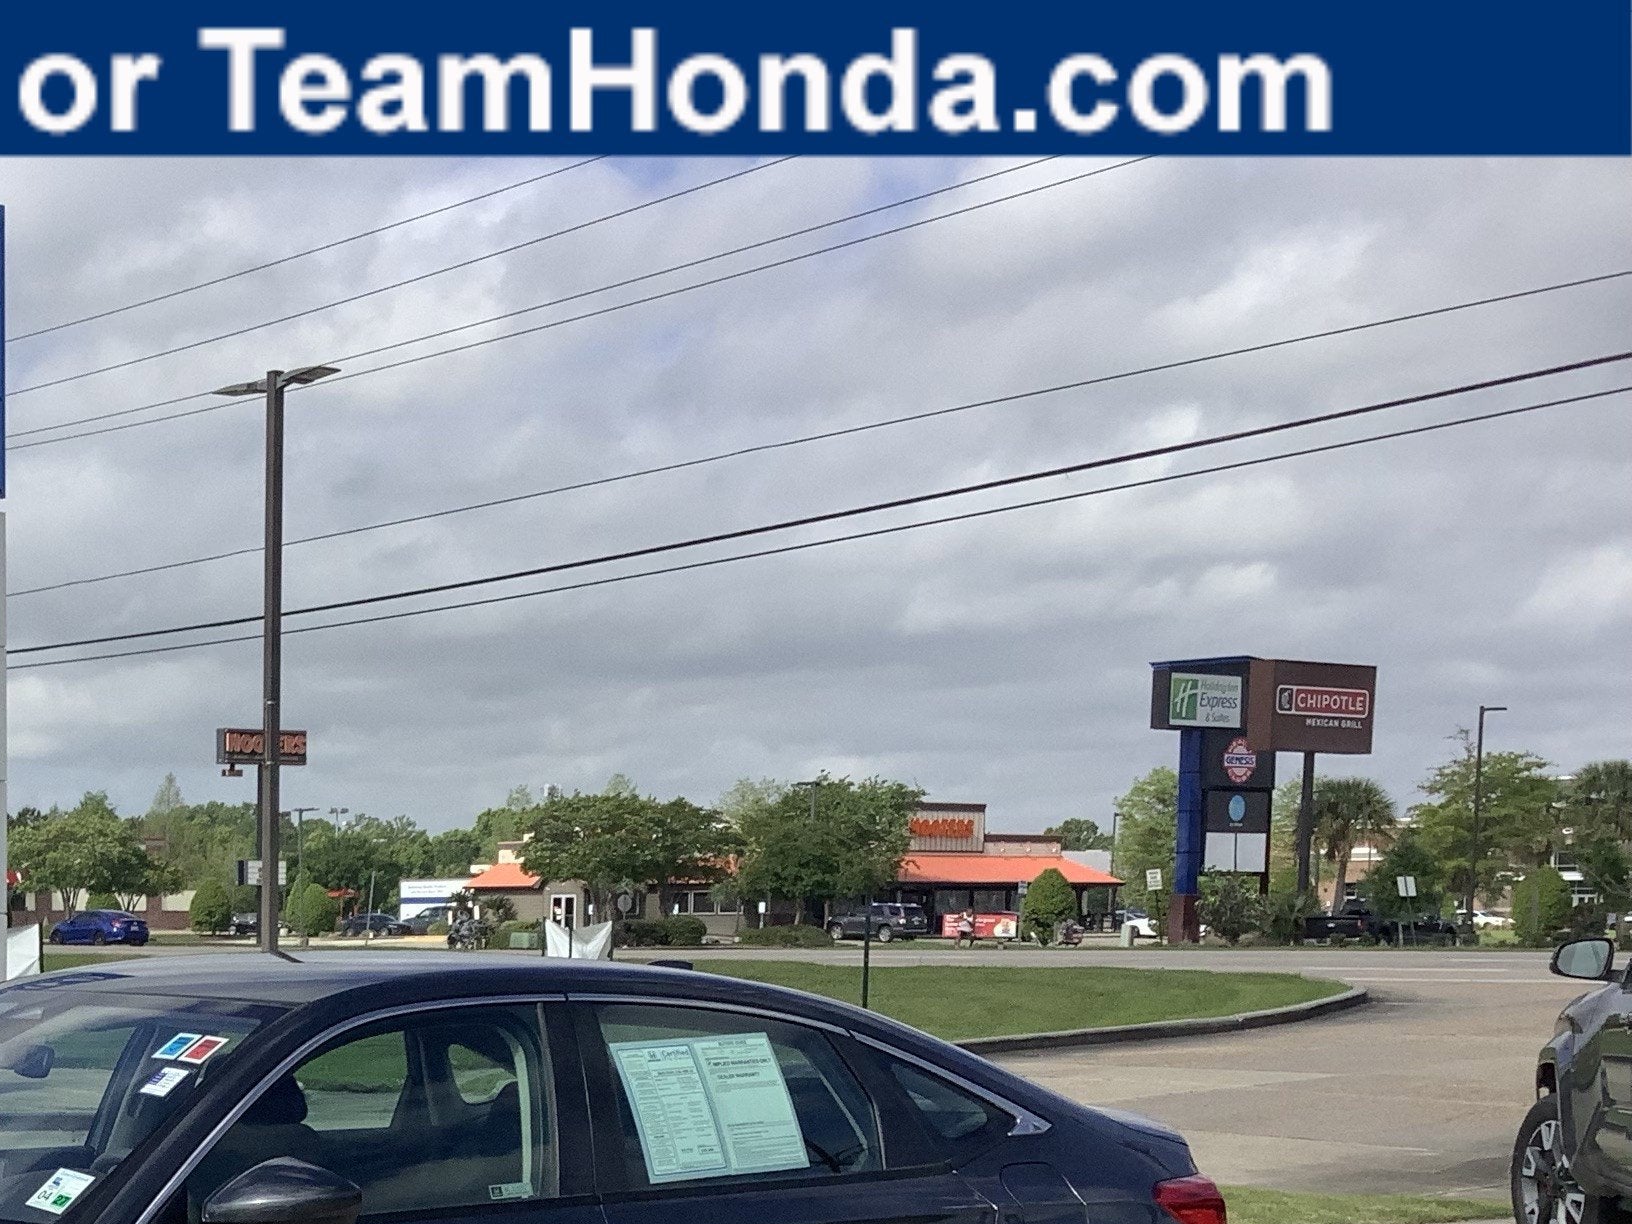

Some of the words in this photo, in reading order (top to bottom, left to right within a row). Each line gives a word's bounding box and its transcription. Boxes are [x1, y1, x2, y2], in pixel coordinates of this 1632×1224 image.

[1199, 692, 1238, 711] Express
[1297, 692, 1364, 711] CHIPOTLE
[1305, 718, 1339, 727] MEXICAN
[1340, 719, 1363, 729] GRILL
[225, 732, 306, 755] HOOERS
[37, 1190, 53, 1201] 04
